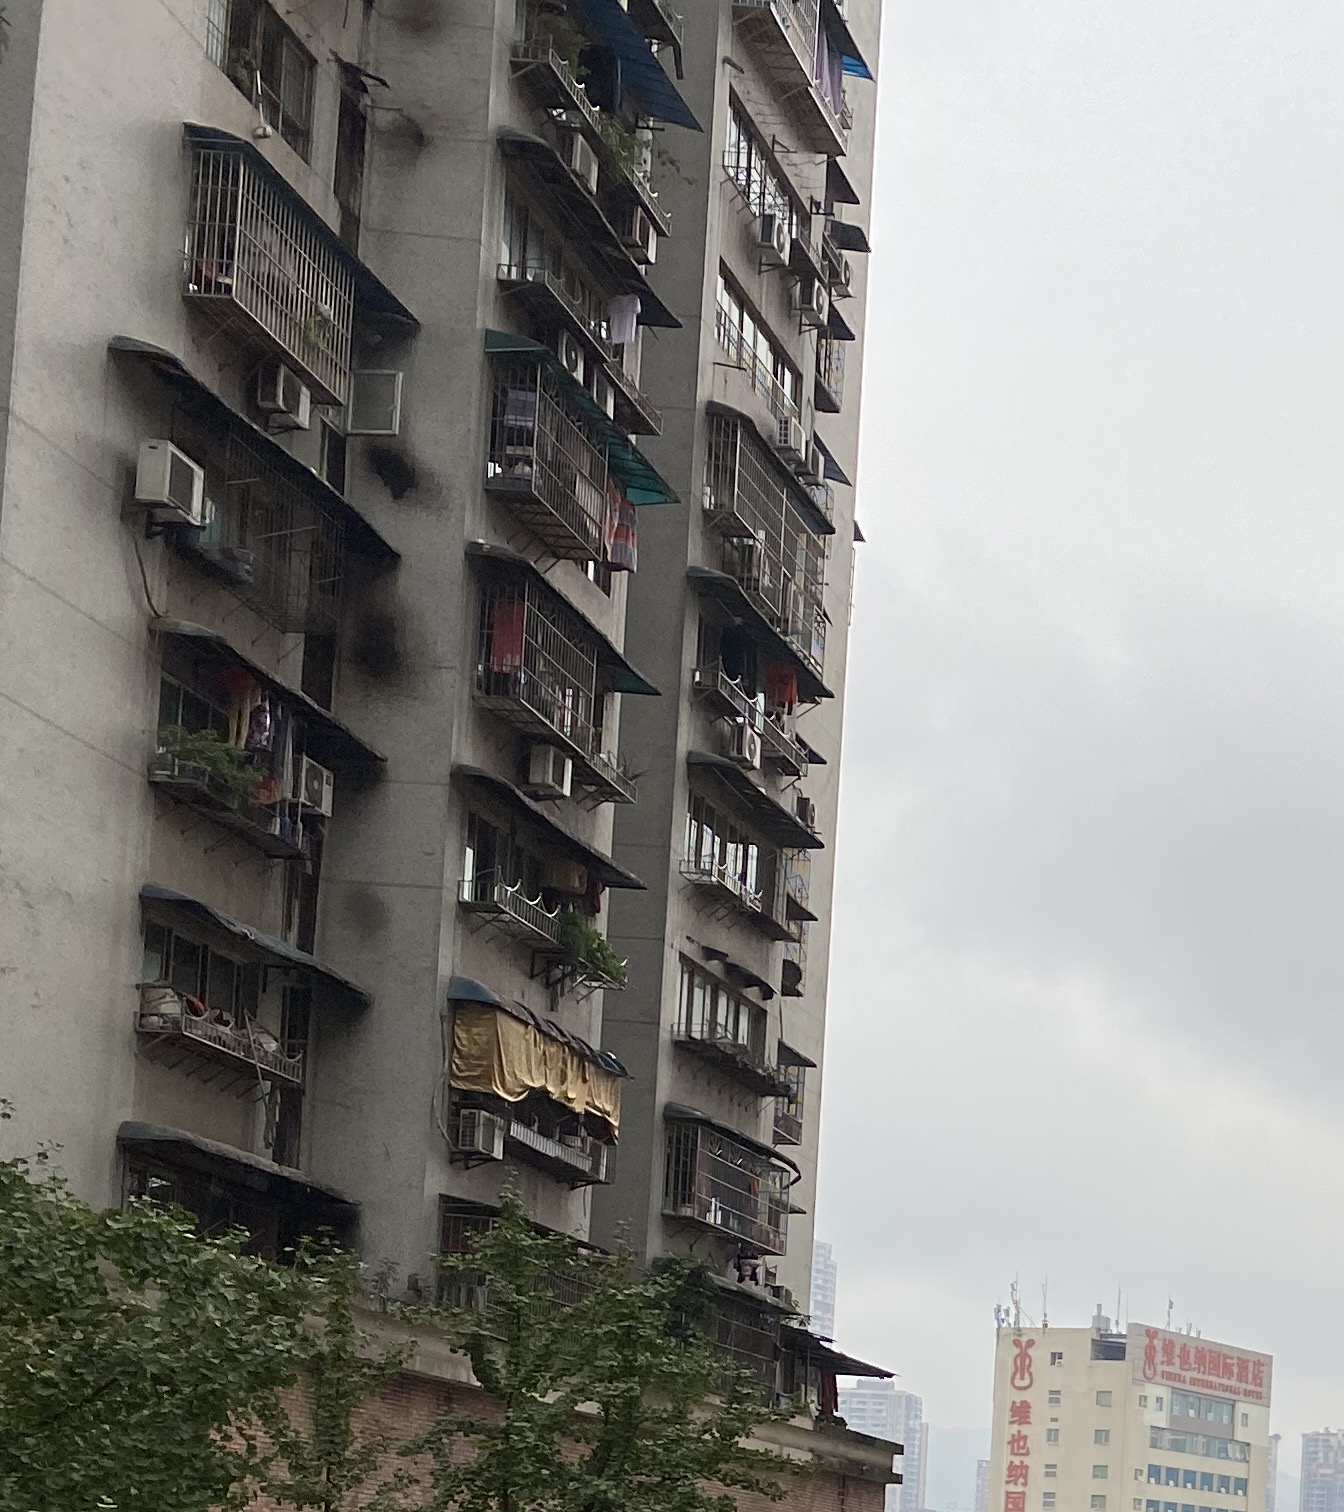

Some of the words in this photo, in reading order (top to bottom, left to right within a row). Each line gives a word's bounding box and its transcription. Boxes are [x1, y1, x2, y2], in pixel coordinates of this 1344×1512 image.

[1161, 1337, 1265, 1388] 维也纳国际酒店
